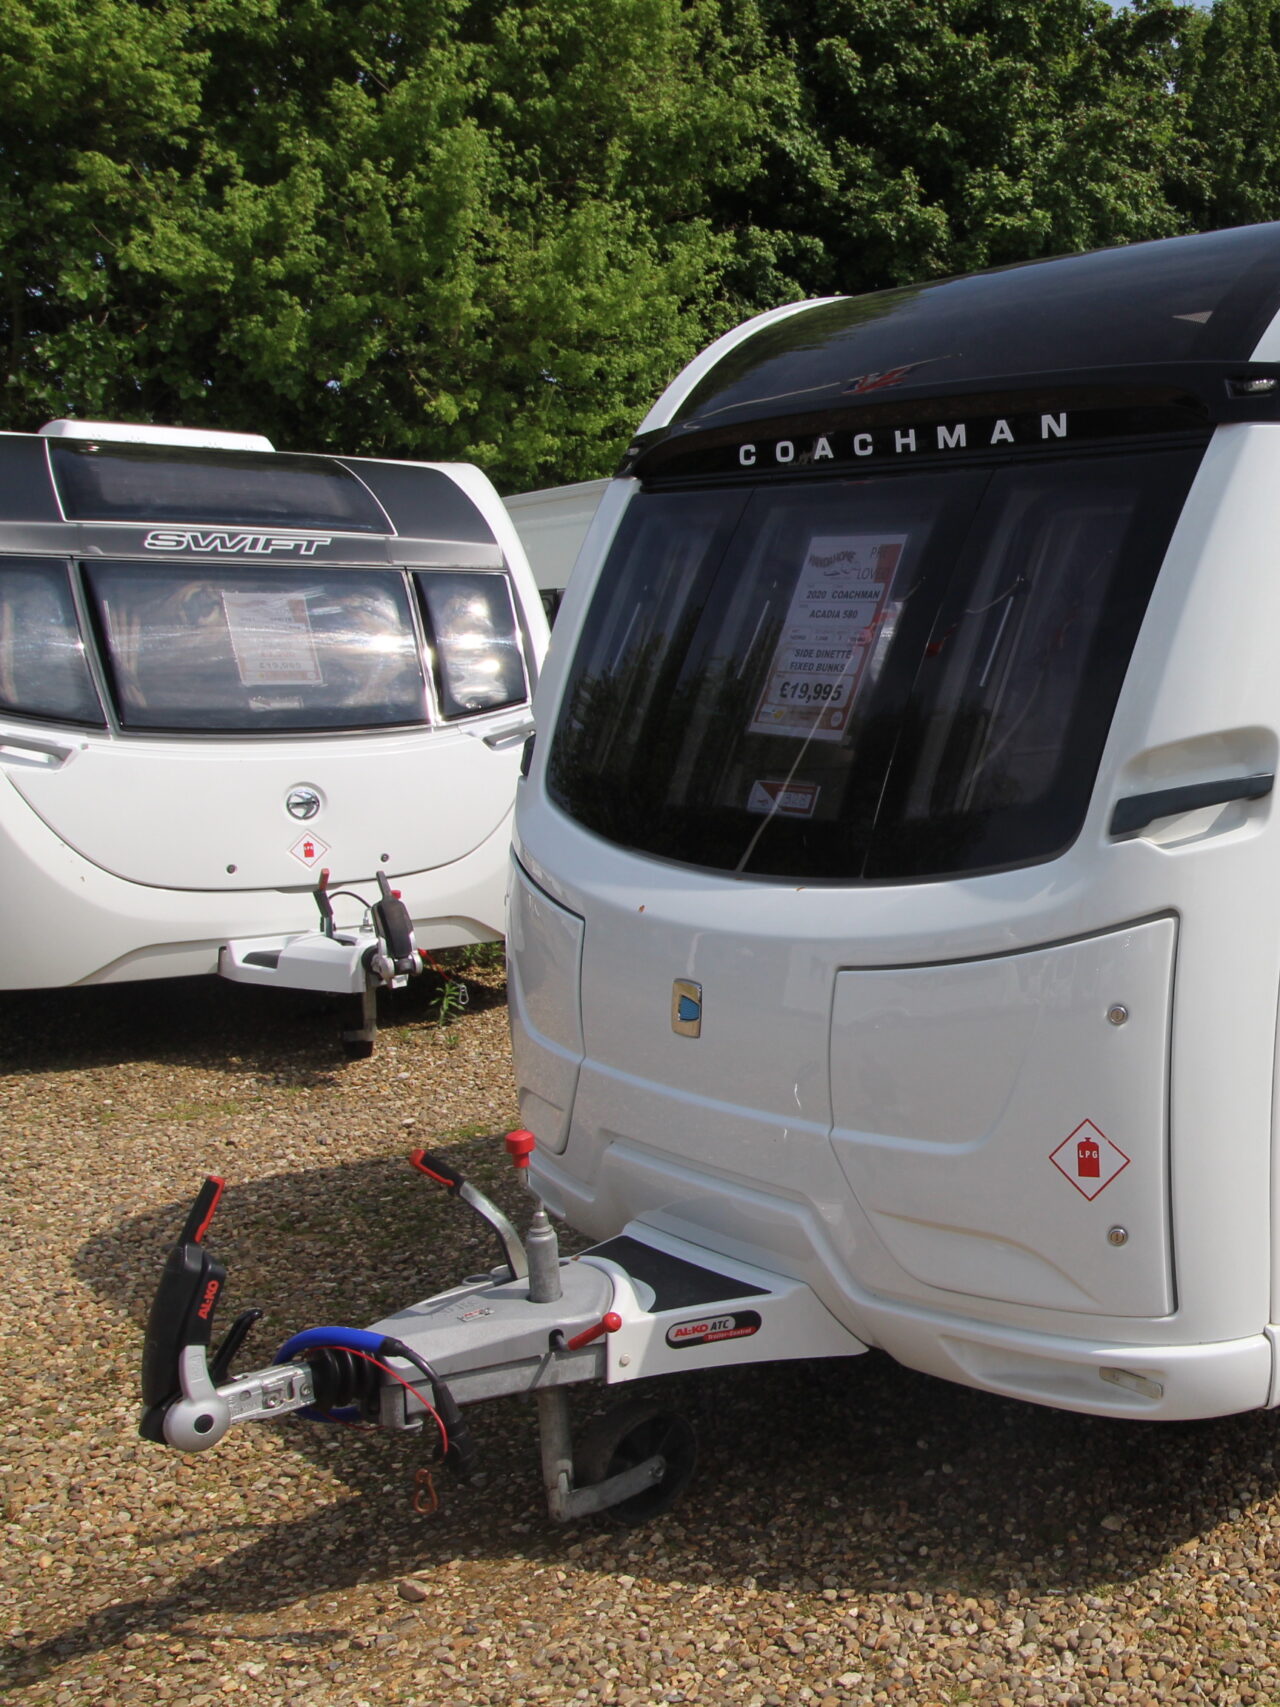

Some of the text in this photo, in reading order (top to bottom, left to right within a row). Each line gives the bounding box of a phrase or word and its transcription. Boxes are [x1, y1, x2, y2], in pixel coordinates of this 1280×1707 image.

[739, 412, 1067, 466] COACHMAN
[144, 530, 333, 556] SWIFT
[806, 590, 881, 600] 2020 COACHMAN
[809, 609, 858, 619] ACADIA 580
[794, 648, 852, 659] SIDE DINETTE
[789, 662, 846, 673] FIXED BUNKS
[779, 681, 844, 703] £19,995
[1078, 1150, 1098, 1159] LPG
[710, 1319, 730, 1331] ATC
